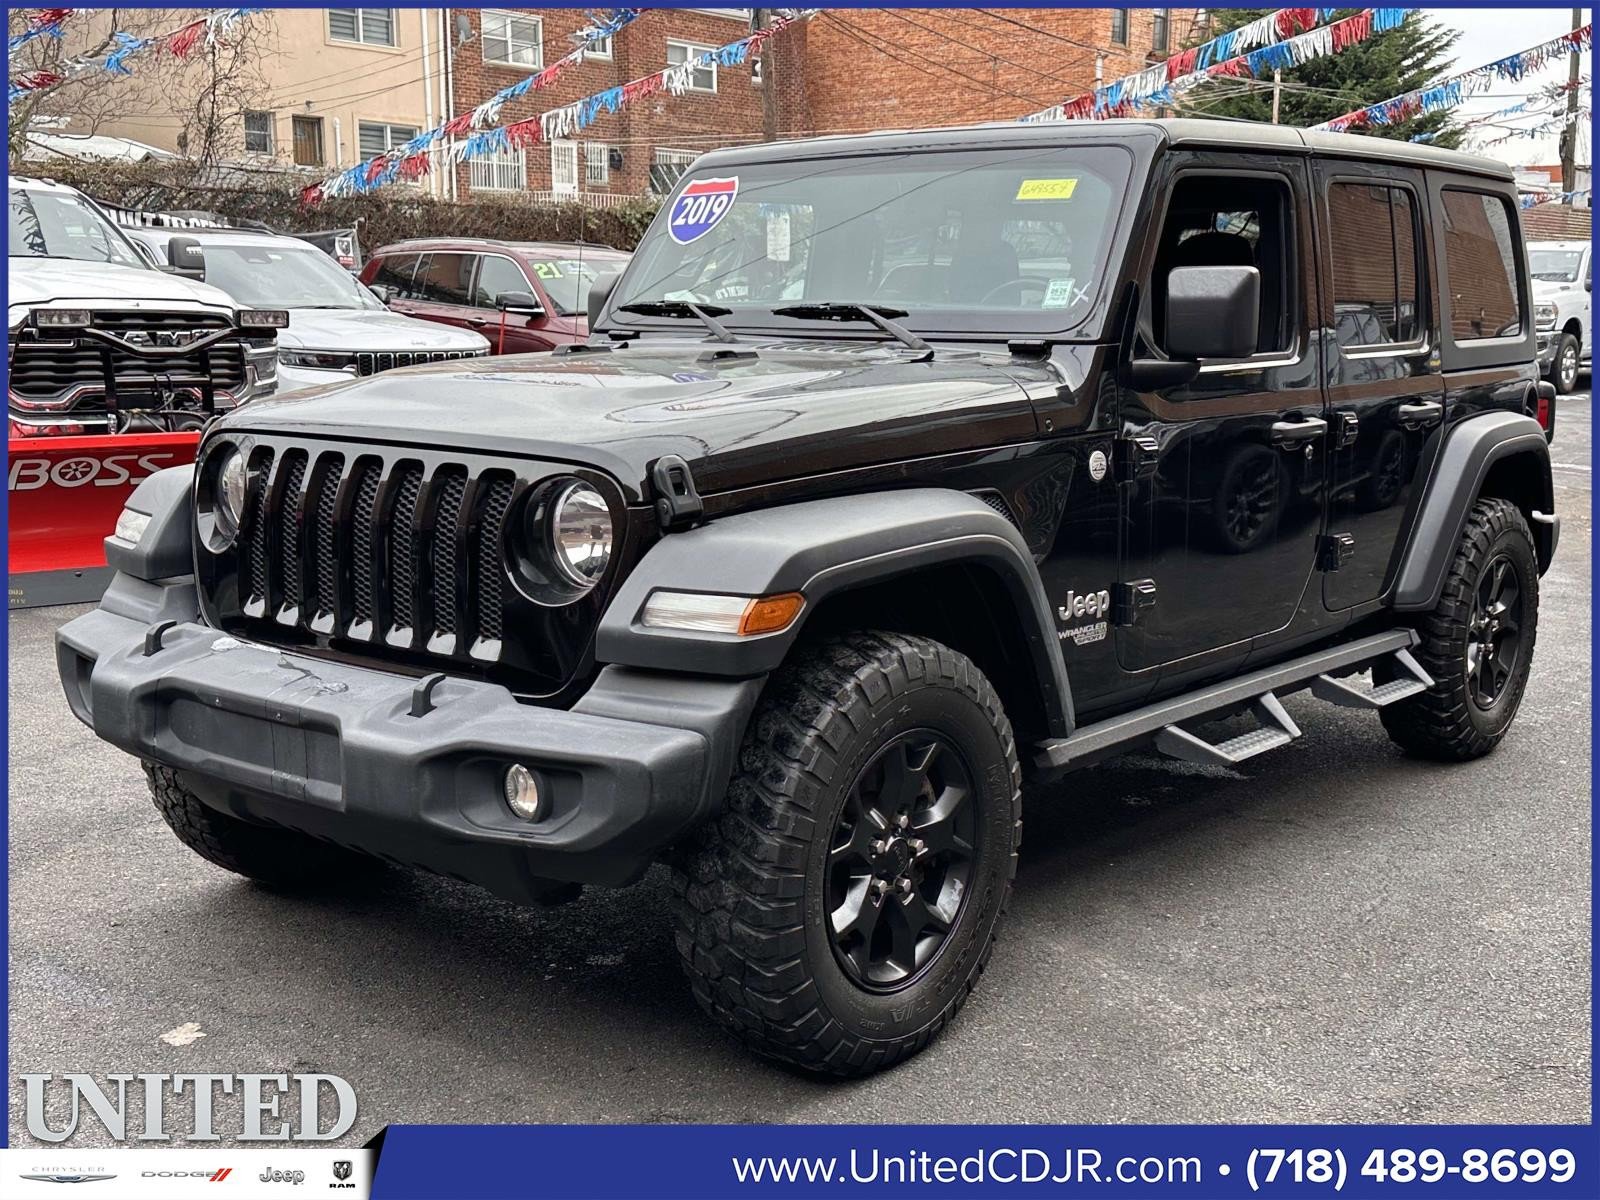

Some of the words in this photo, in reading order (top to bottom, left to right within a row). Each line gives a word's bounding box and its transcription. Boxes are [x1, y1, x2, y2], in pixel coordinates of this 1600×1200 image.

[672, 194, 729, 226] 2019
[533, 262, 564, 279] 21
[8, 453, 174, 491] BOSS
[1058, 589, 1110, 621] Jeep
[1058, 621, 1107, 640] WRANGLER
